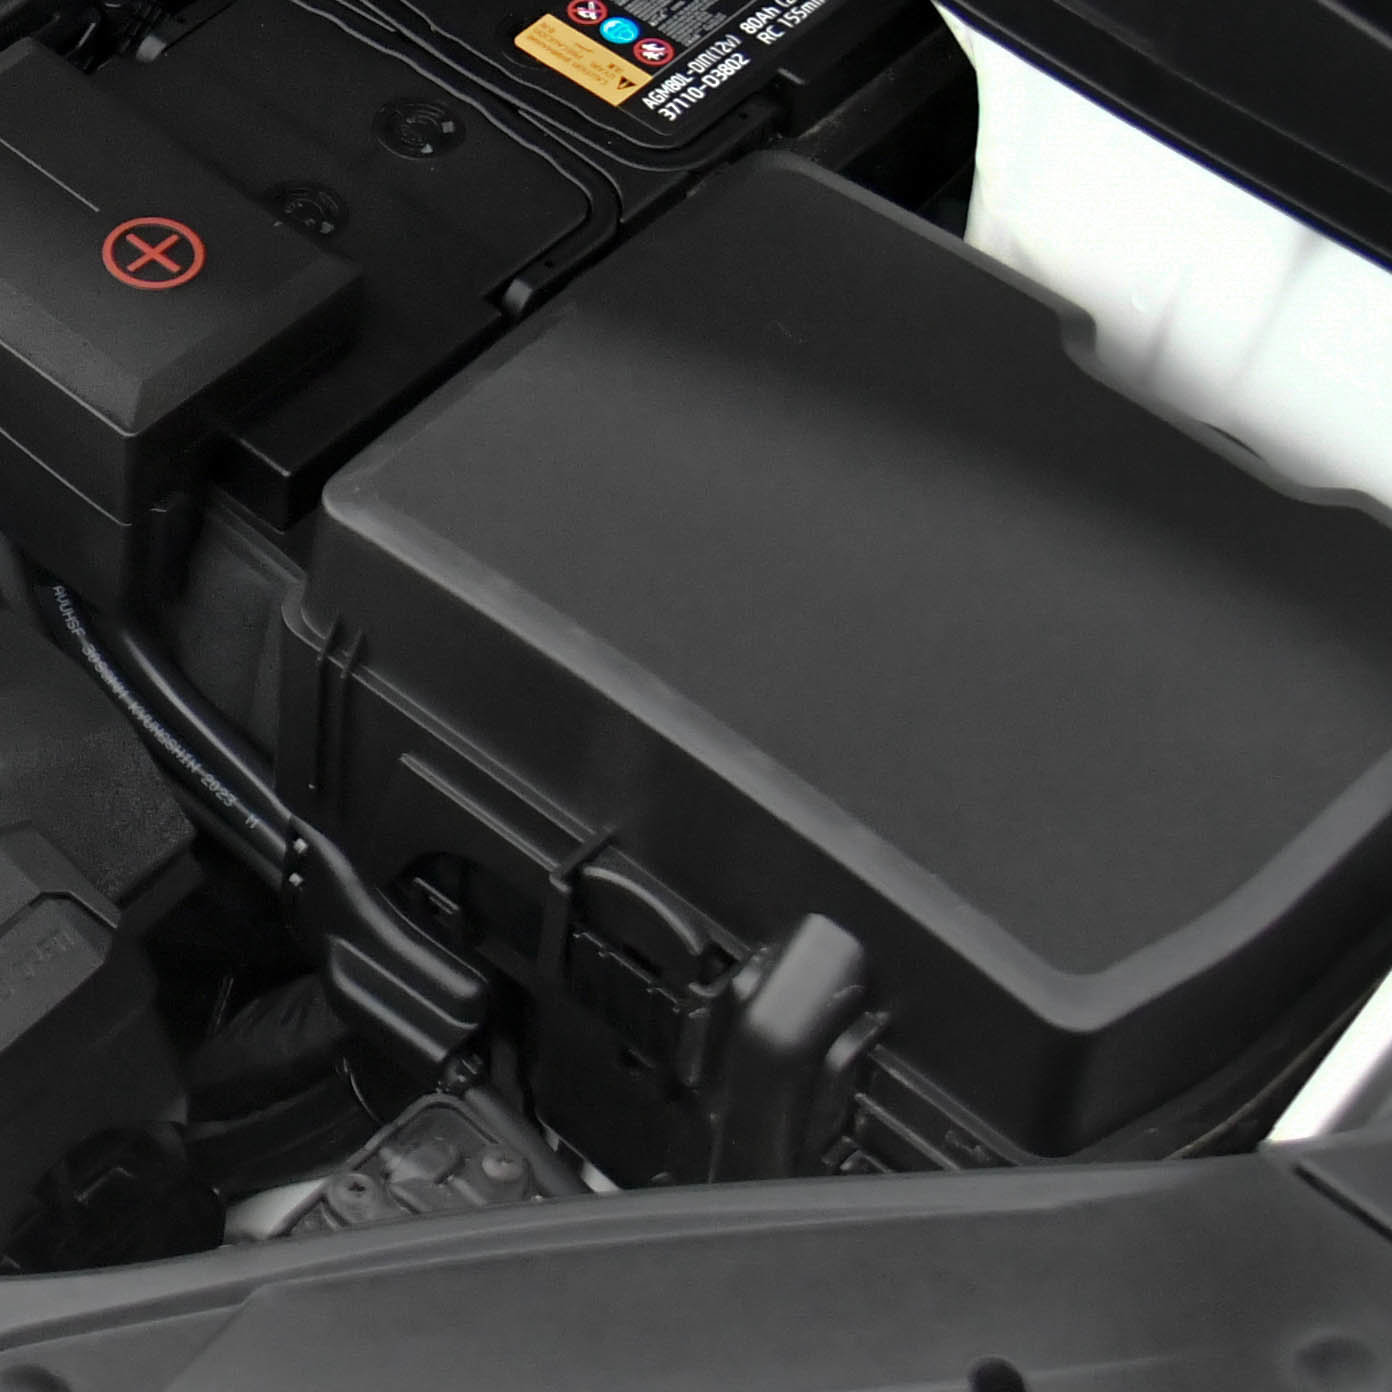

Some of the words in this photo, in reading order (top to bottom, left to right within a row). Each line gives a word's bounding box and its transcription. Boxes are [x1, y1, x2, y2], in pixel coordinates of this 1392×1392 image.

[739, 5, 782, 35] 80Ah
[657, 51, 752, 122] 37110-D3802
[756, 24, 786, 46] RC
[200, 772, 237, 808] 2023
